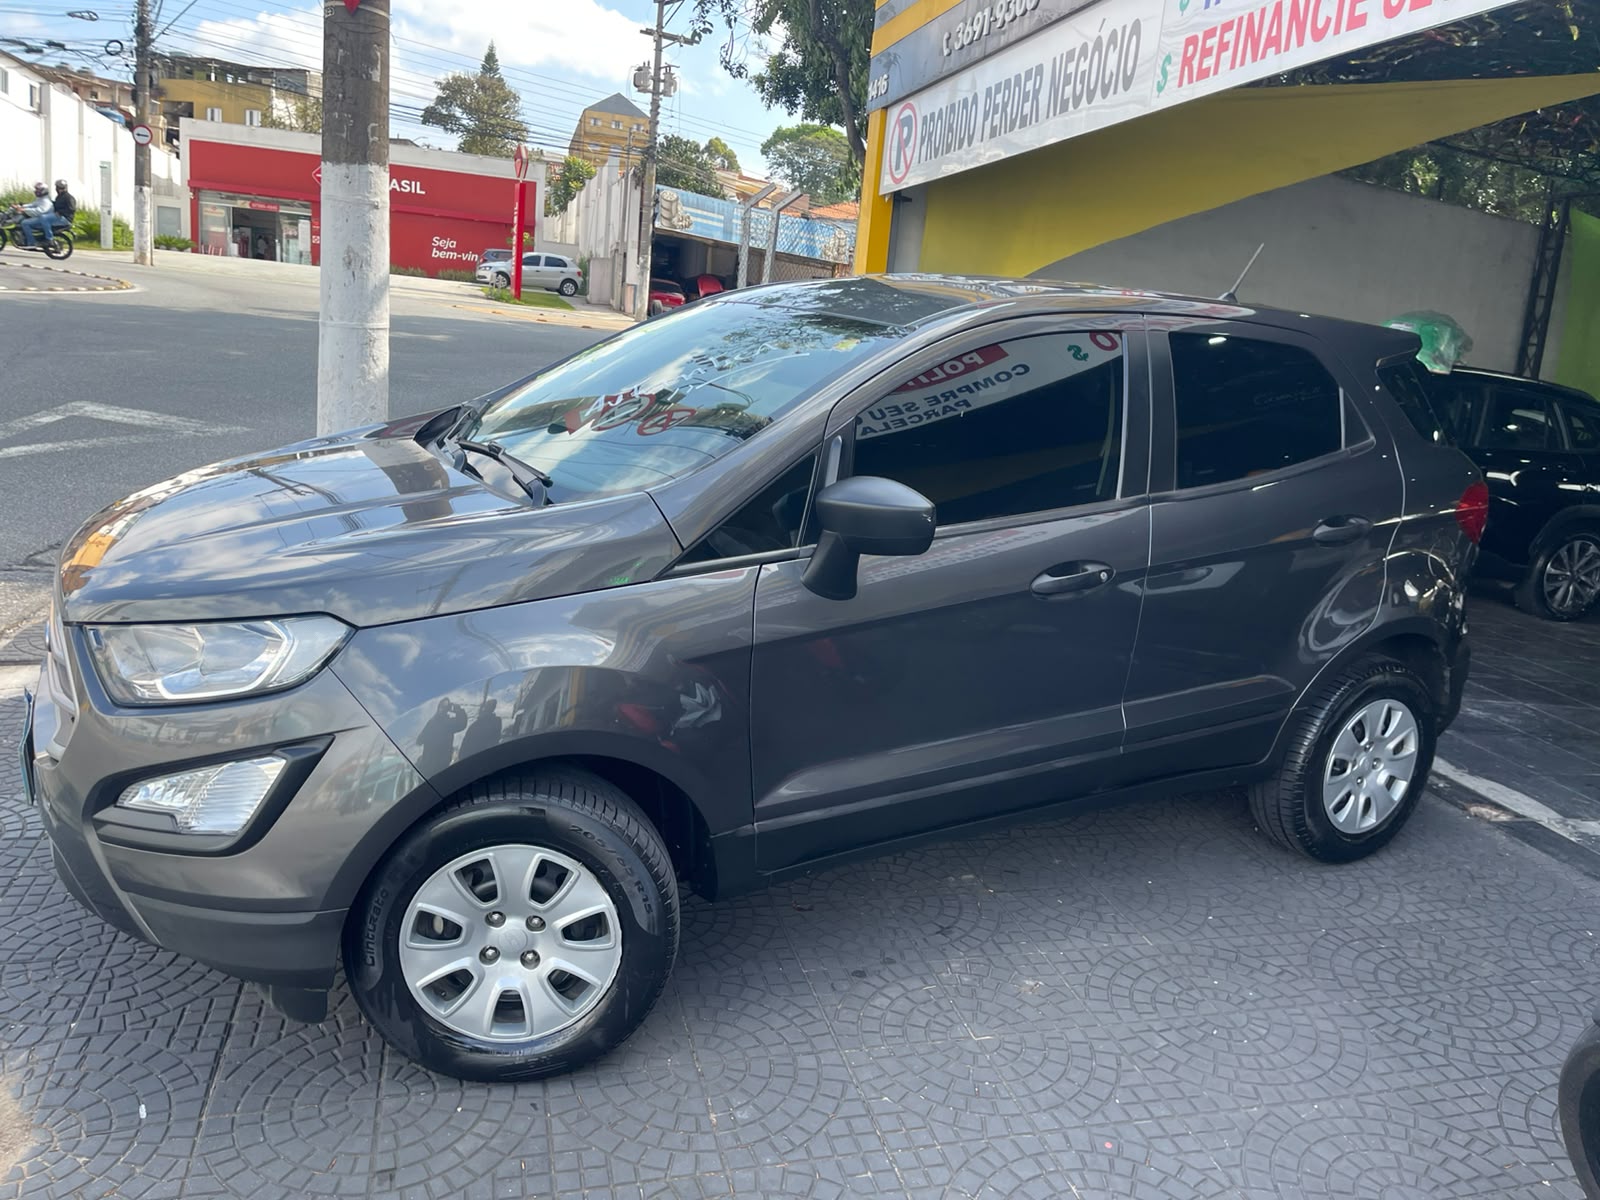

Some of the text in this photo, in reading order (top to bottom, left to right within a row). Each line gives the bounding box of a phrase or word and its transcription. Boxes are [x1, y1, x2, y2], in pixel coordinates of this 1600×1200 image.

[1178, 0, 1368, 88] REFINANCIE
[918, 92, 979, 165] PROIBIDO
[981, 63, 1045, 143] PERDER
[1046, 18, 1142, 119] NEGÓCIO
[431, 236, 457, 249] Seja
